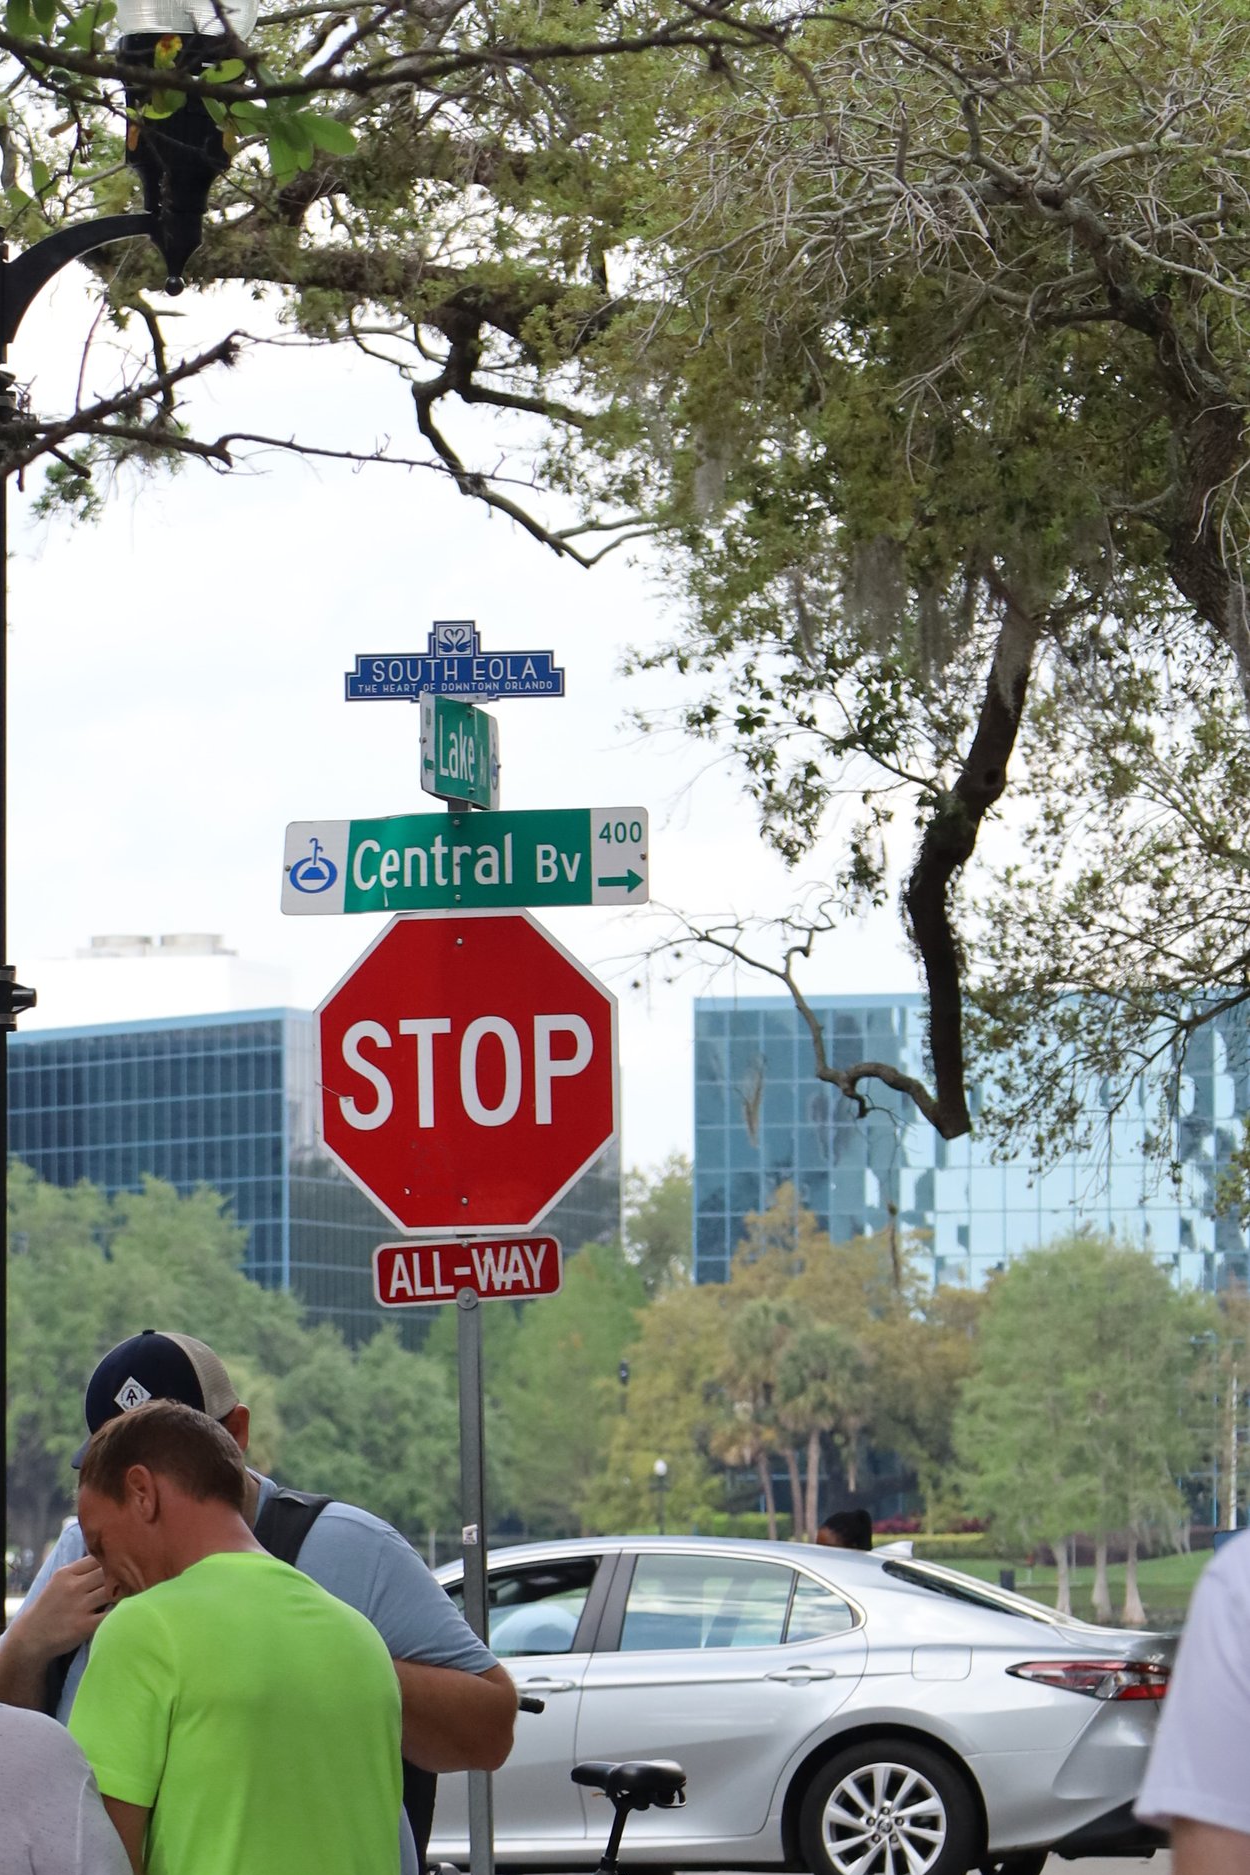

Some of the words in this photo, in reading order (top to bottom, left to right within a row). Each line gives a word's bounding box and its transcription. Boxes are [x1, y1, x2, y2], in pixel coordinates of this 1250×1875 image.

[358, 684, 378, 693] THE
[383, 683, 417, 693] HEART
[423, 682, 436, 691] OF
[442, 681, 500, 691] DOWNTOWN
[505, 680, 553, 690] ORLANDO
[372, 659, 458, 682] SOUTH
[473, 657, 538, 680] EOLA
[439, 713, 475, 783] Lake
[599, 821, 643, 844] 400
[352, 832, 513, 891] Central
[536, 844, 582, 883] Bv
[338, 1014, 594, 1131] STOP
[389, 1244, 548, 1298] ALL-WAY
